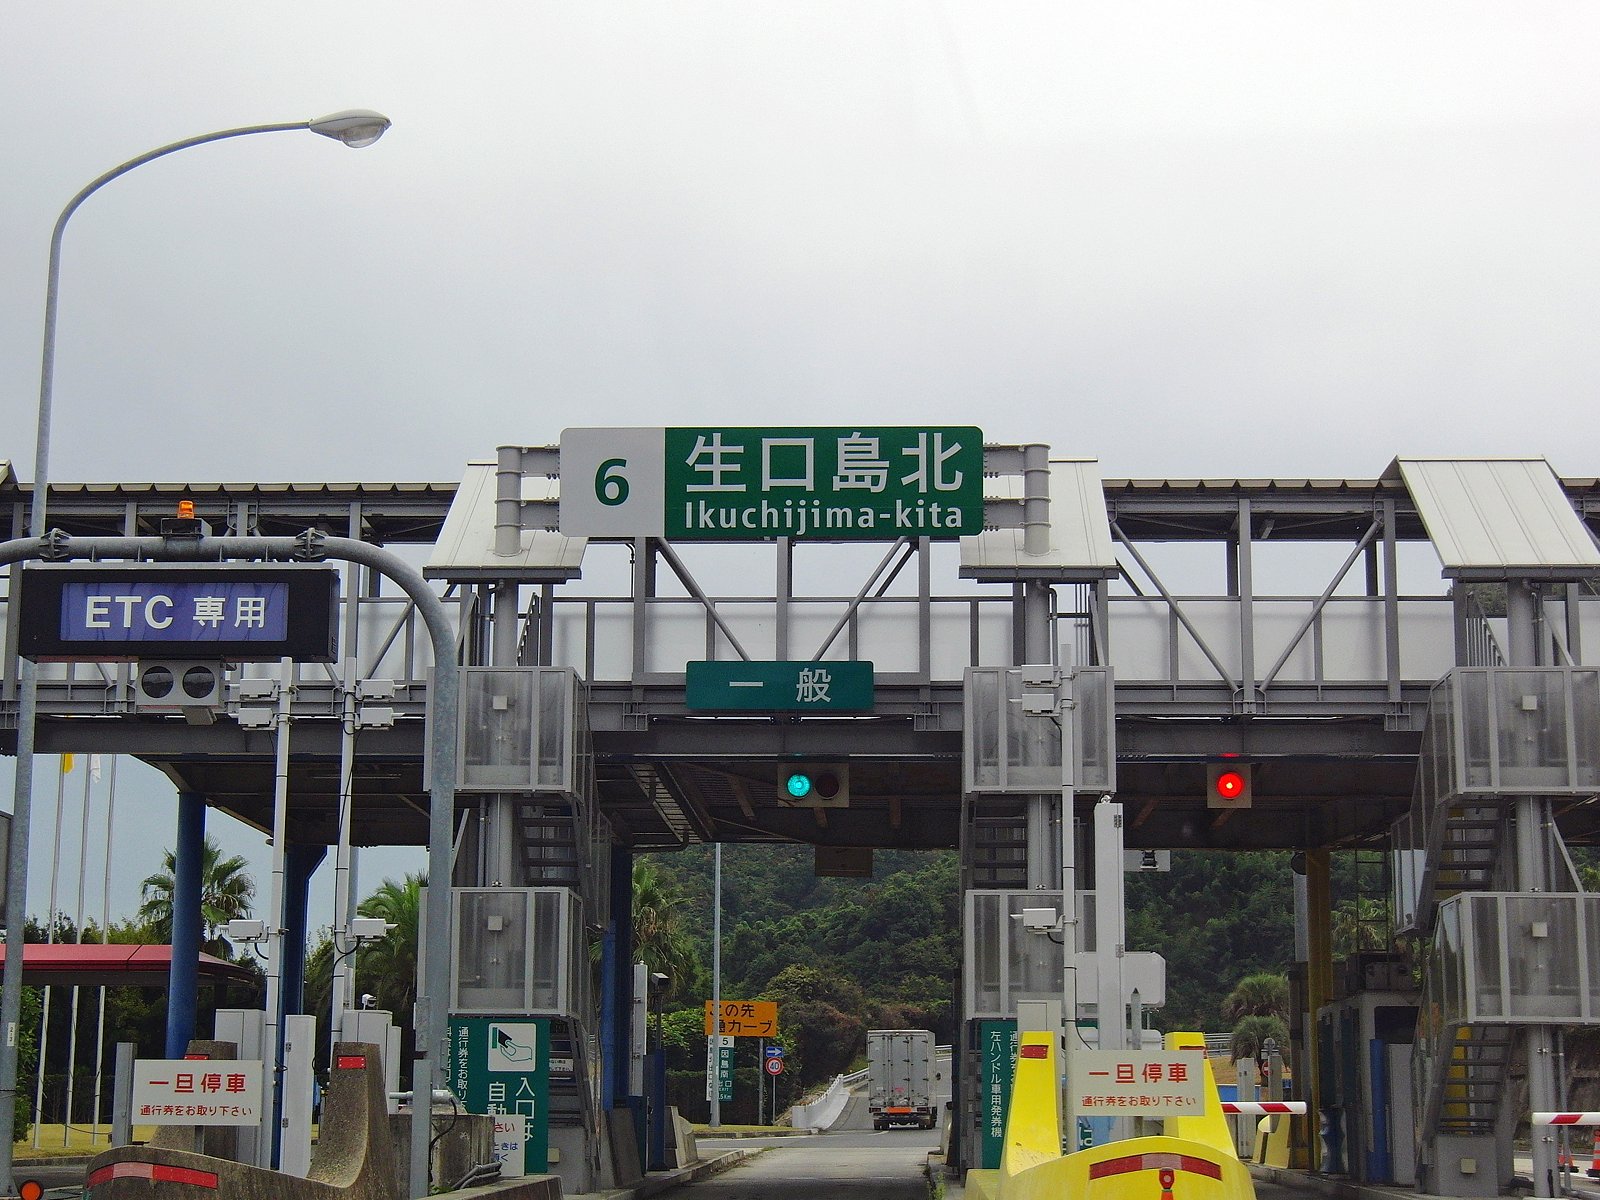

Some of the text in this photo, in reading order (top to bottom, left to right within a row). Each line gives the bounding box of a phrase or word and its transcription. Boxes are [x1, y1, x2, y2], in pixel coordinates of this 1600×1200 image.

[685, 431, 963, 494] 生口島北
[595, 458, 630, 506] 6
[685, 499, 963, 535] Ikuchijima-kita
[86, 595, 265, 629] ETC 専用
[729, 667, 832, 703] 一般
[722, 1037, 729, 1046] 5
[769, 1061, 780, 1070] 40
[1088, 1063, 1188, 1084] 一旦停車
[149, 1073, 246, 1094] 一旦停車
[990, 1031, 1003, 1138] 左ハンドル車用発券機
[140, 1105, 252, 1117] 通行券をお取り下さい
[1082, 1095, 1197, 1107] 通行券をお取り下さい
